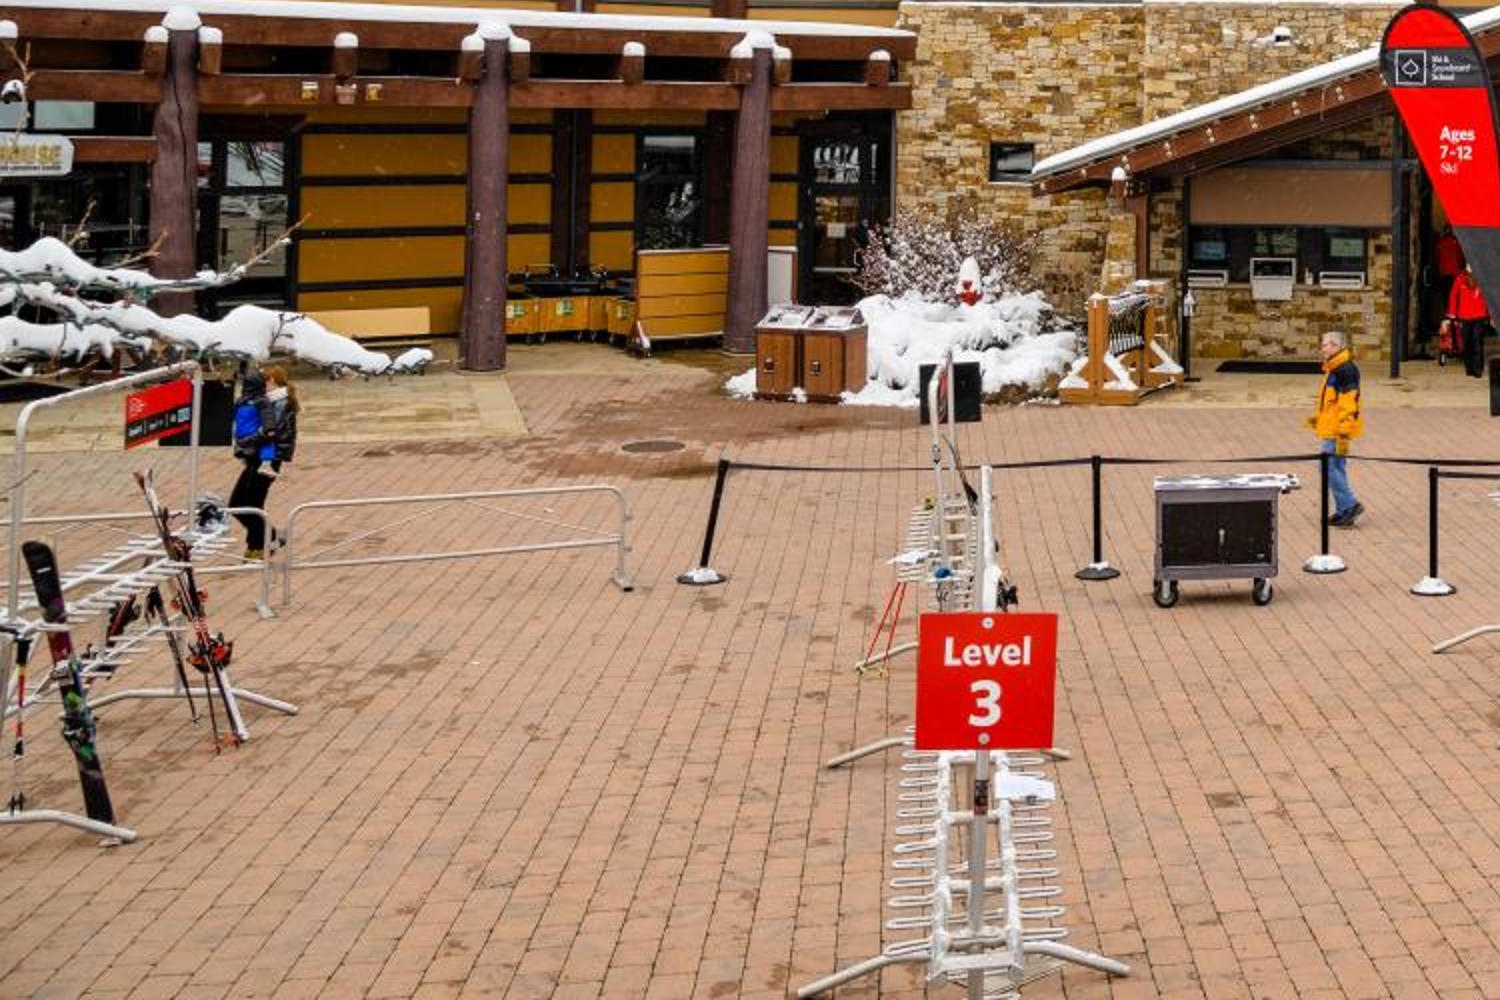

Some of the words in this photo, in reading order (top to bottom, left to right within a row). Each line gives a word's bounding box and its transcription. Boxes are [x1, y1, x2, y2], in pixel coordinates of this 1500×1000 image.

[1440, 125, 1475, 144] Ages
[1440, 145, 1472, 160] 7-12
[1441, 161, 1458, 173] Ski
[943, 635, 1032, 667] Level
[968, 679, 1003, 727] 3
